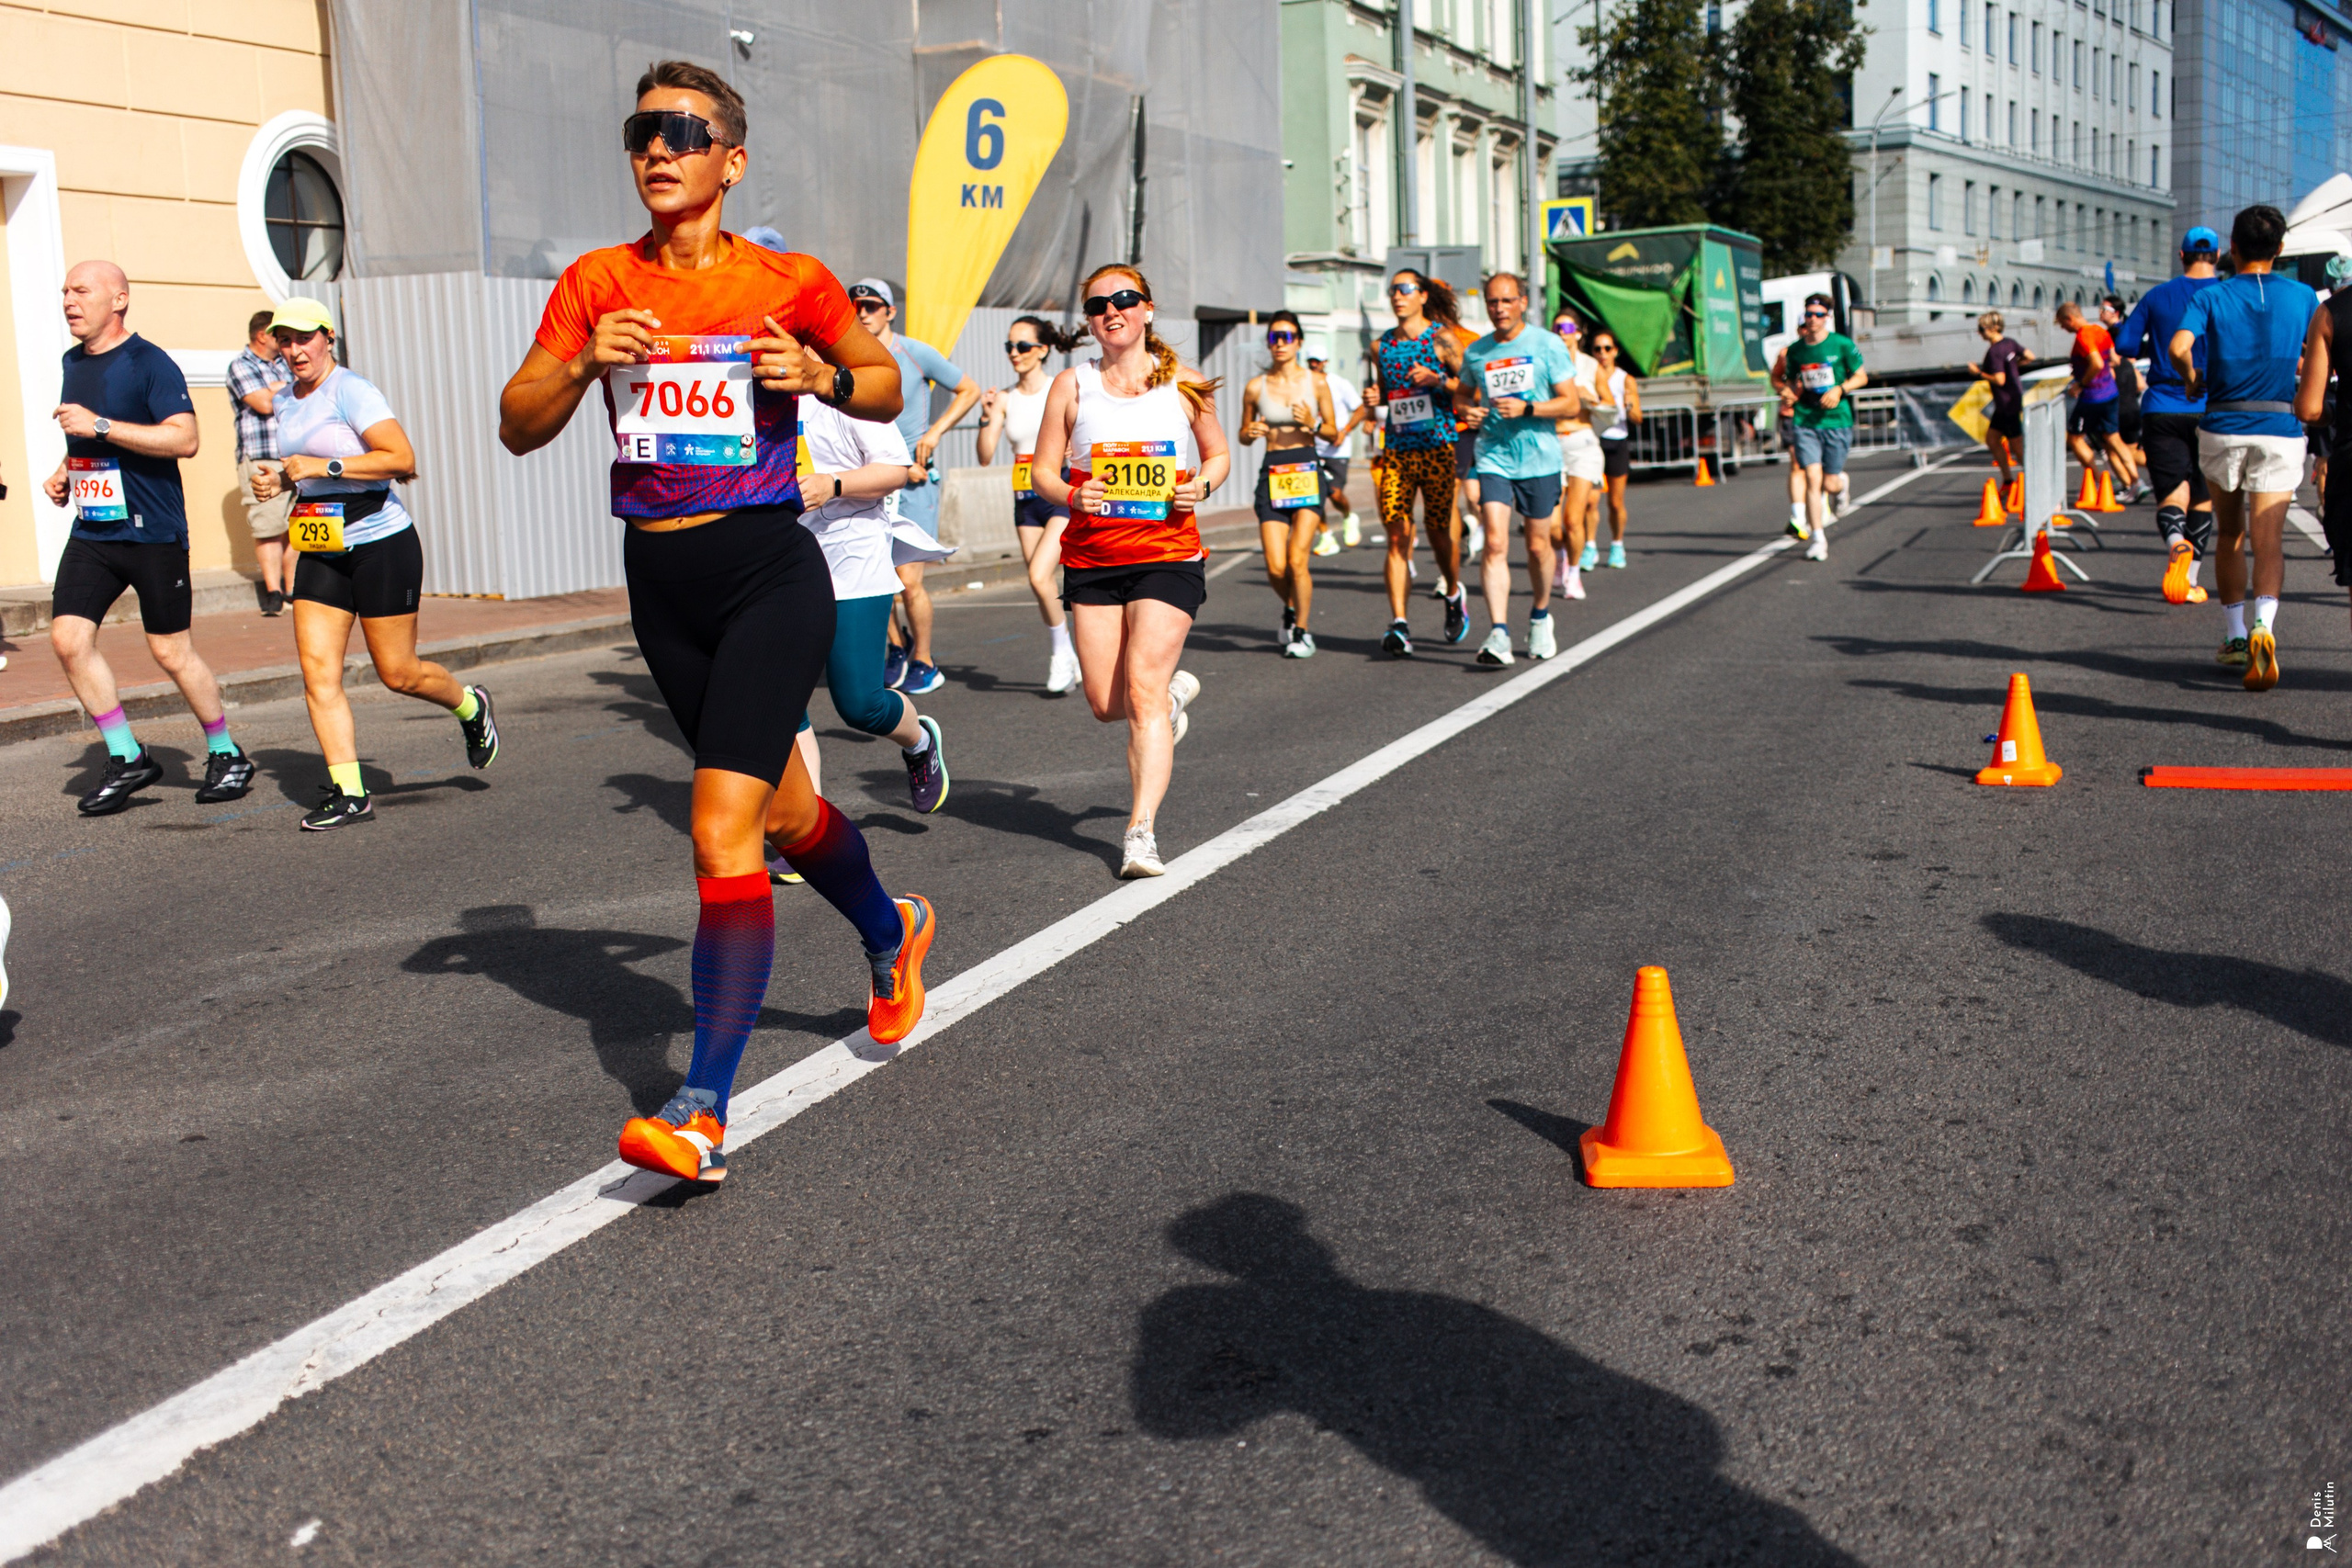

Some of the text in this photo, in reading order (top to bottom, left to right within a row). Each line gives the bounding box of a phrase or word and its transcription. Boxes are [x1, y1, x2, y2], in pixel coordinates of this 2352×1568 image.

[966, 97, 1006, 171] 6
[690, 344, 710, 356] 21,1
[1492, 369, 1525, 388] 3729
[629, 380, 735, 419] 7066
[1395, 399, 1425, 415] 4919
[637, 438, 650, 458] E
[1141, 445, 1154, 453] 21,1
[1103, 463, 1166, 487] 3108
[1278, 477, 1310, 490] 4920
[74, 479, 114, 498] 6996
[1109, 489, 1161, 497] АЛЕКСАНДРА
[1101, 502, 1111, 515] D
[299, 523, 330, 542] 293
